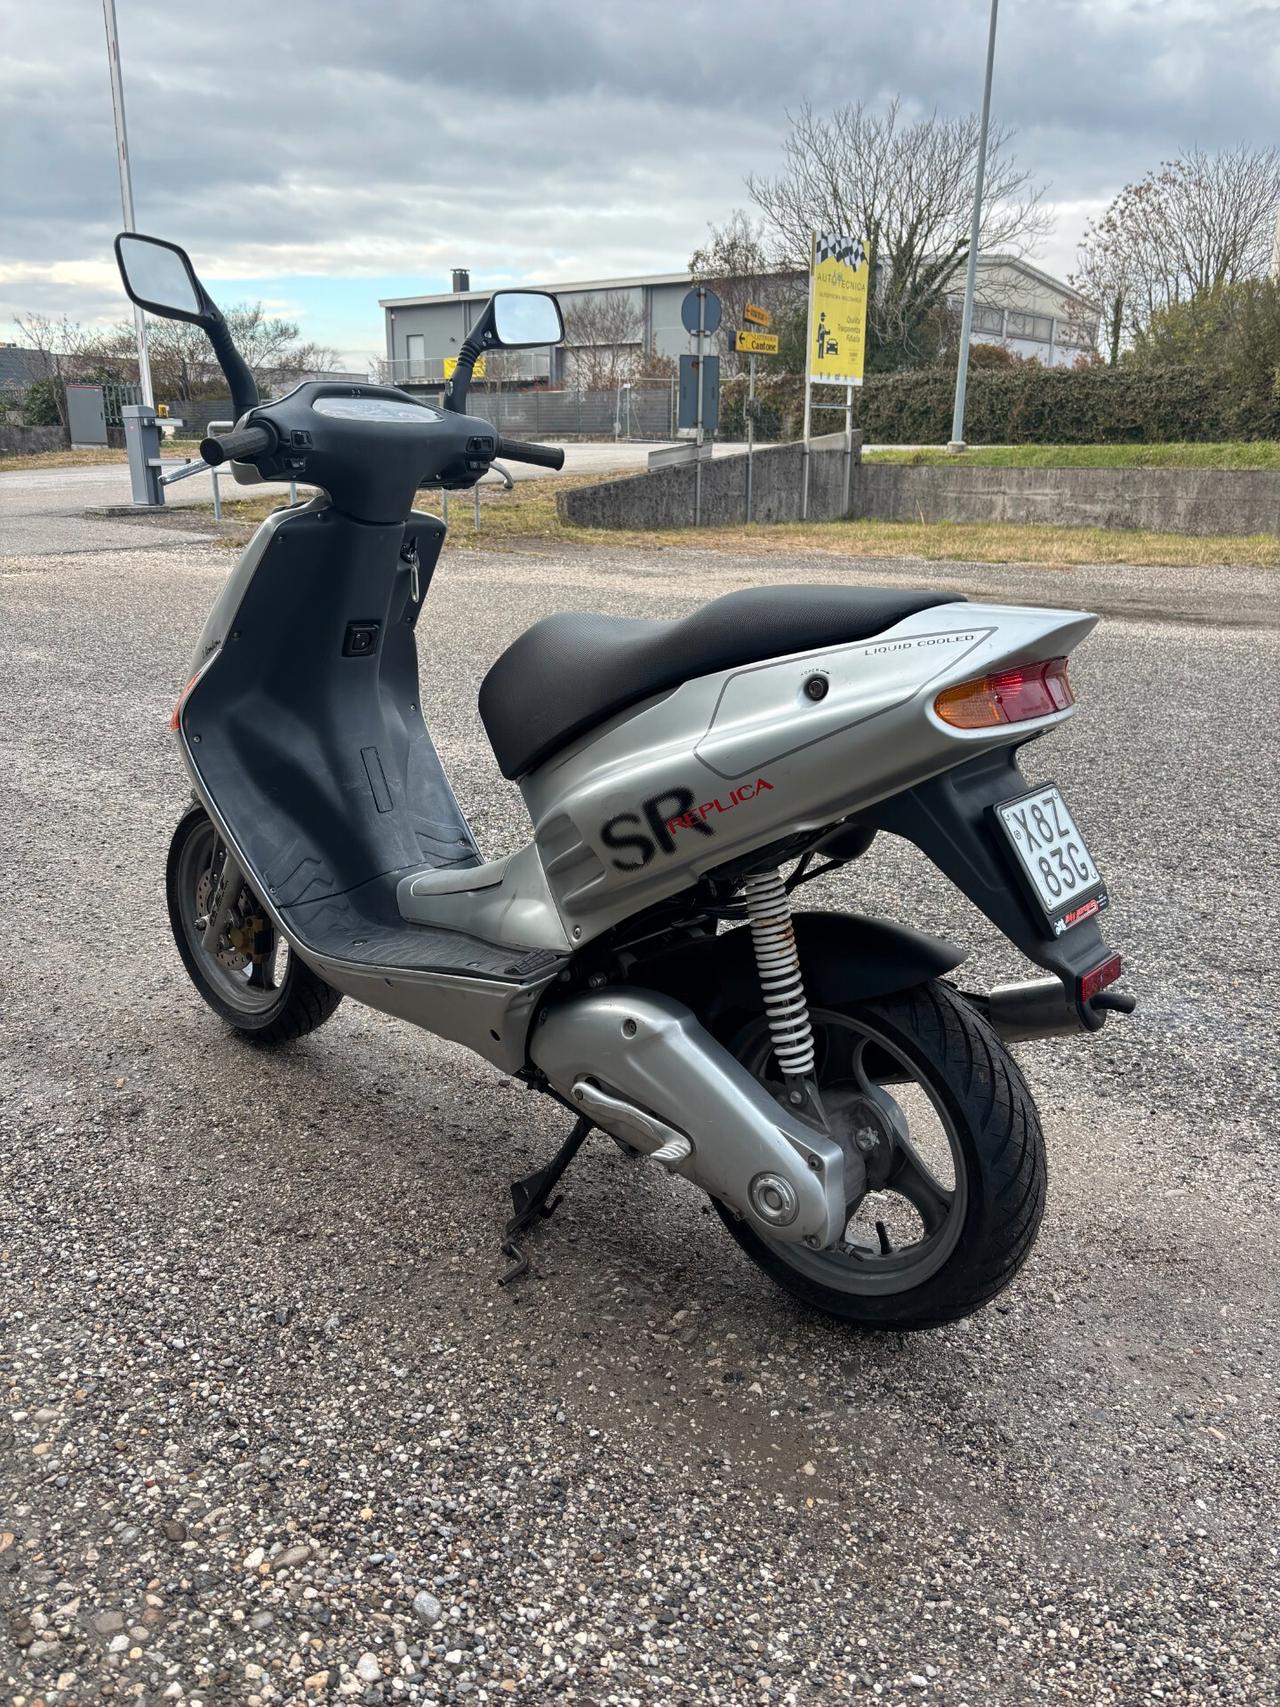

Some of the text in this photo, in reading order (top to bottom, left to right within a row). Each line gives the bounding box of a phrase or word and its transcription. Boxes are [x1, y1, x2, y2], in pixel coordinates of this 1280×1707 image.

[751, 340, 776, 351] Cantone
[864, 635, 974, 656] LIQUID COOLED
[601, 786, 715, 872] SR
[666, 778, 774, 835] REPLICA
[1012, 796, 1070, 853] X8Z
